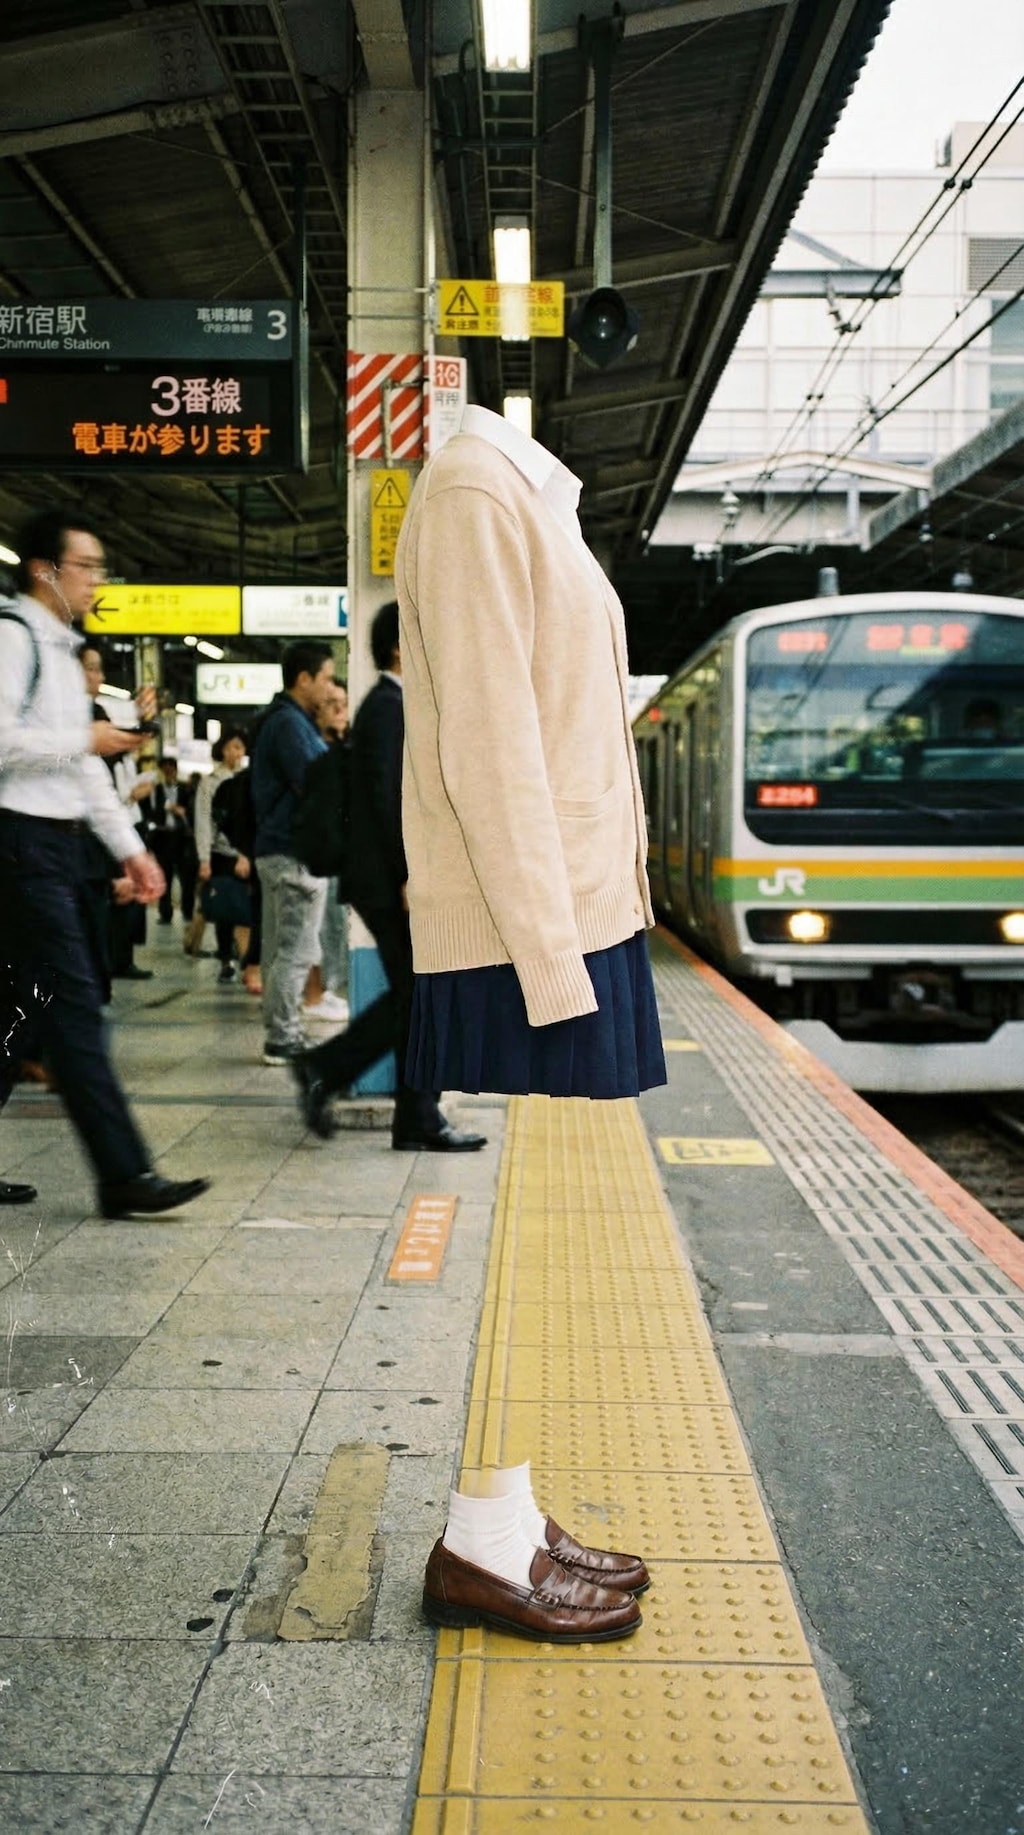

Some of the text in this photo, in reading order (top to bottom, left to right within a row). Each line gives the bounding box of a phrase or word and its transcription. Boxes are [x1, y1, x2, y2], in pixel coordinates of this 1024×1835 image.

[0, 304, 87, 335] 新宿駅
[266, 309, 287, 340] 3
[63, 336, 110, 350] Station
[151, 375, 242, 417] 3番線
[72, 422, 271, 455] 電車が参ります
[758, 867, 806, 896] JR
